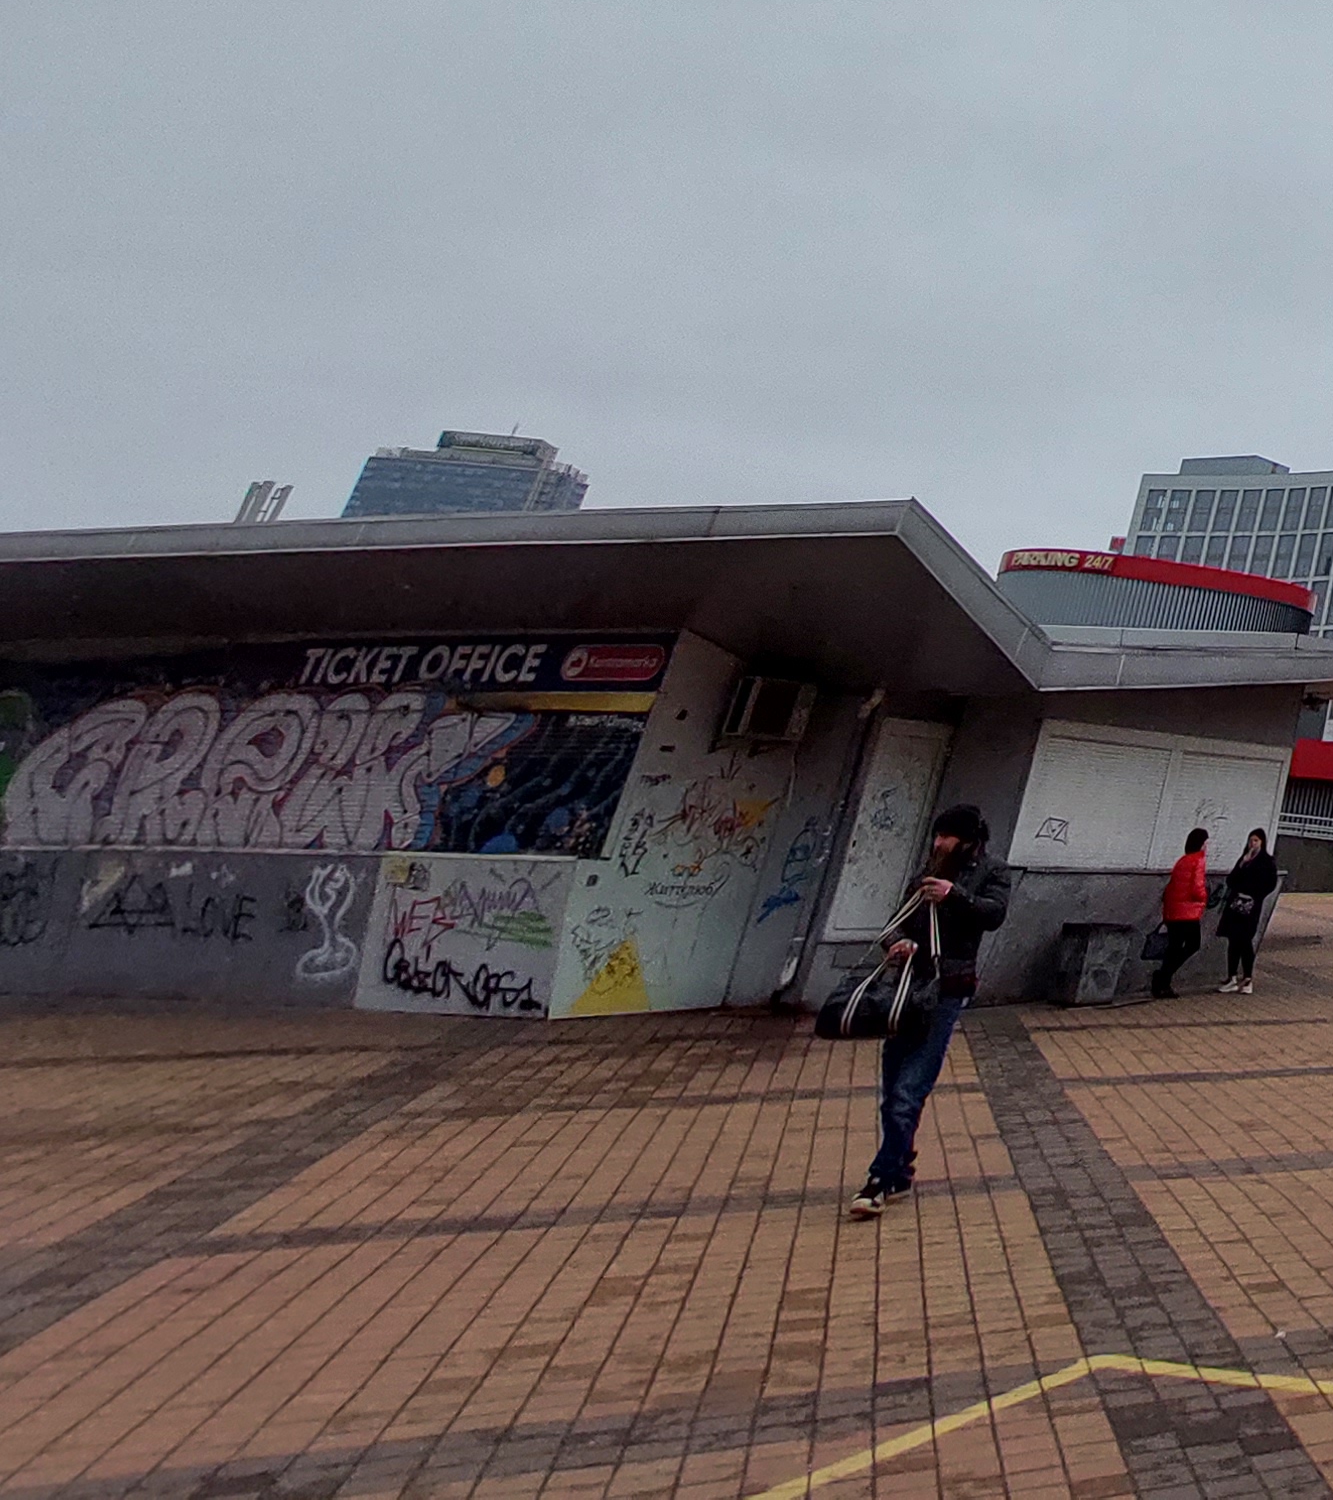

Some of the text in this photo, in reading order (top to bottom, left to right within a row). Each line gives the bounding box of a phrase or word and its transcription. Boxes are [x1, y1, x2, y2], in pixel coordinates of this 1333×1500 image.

[1011, 551, 1115, 571] PARKING 24/7
[299, 643, 548, 685] TICKET OFFICE
